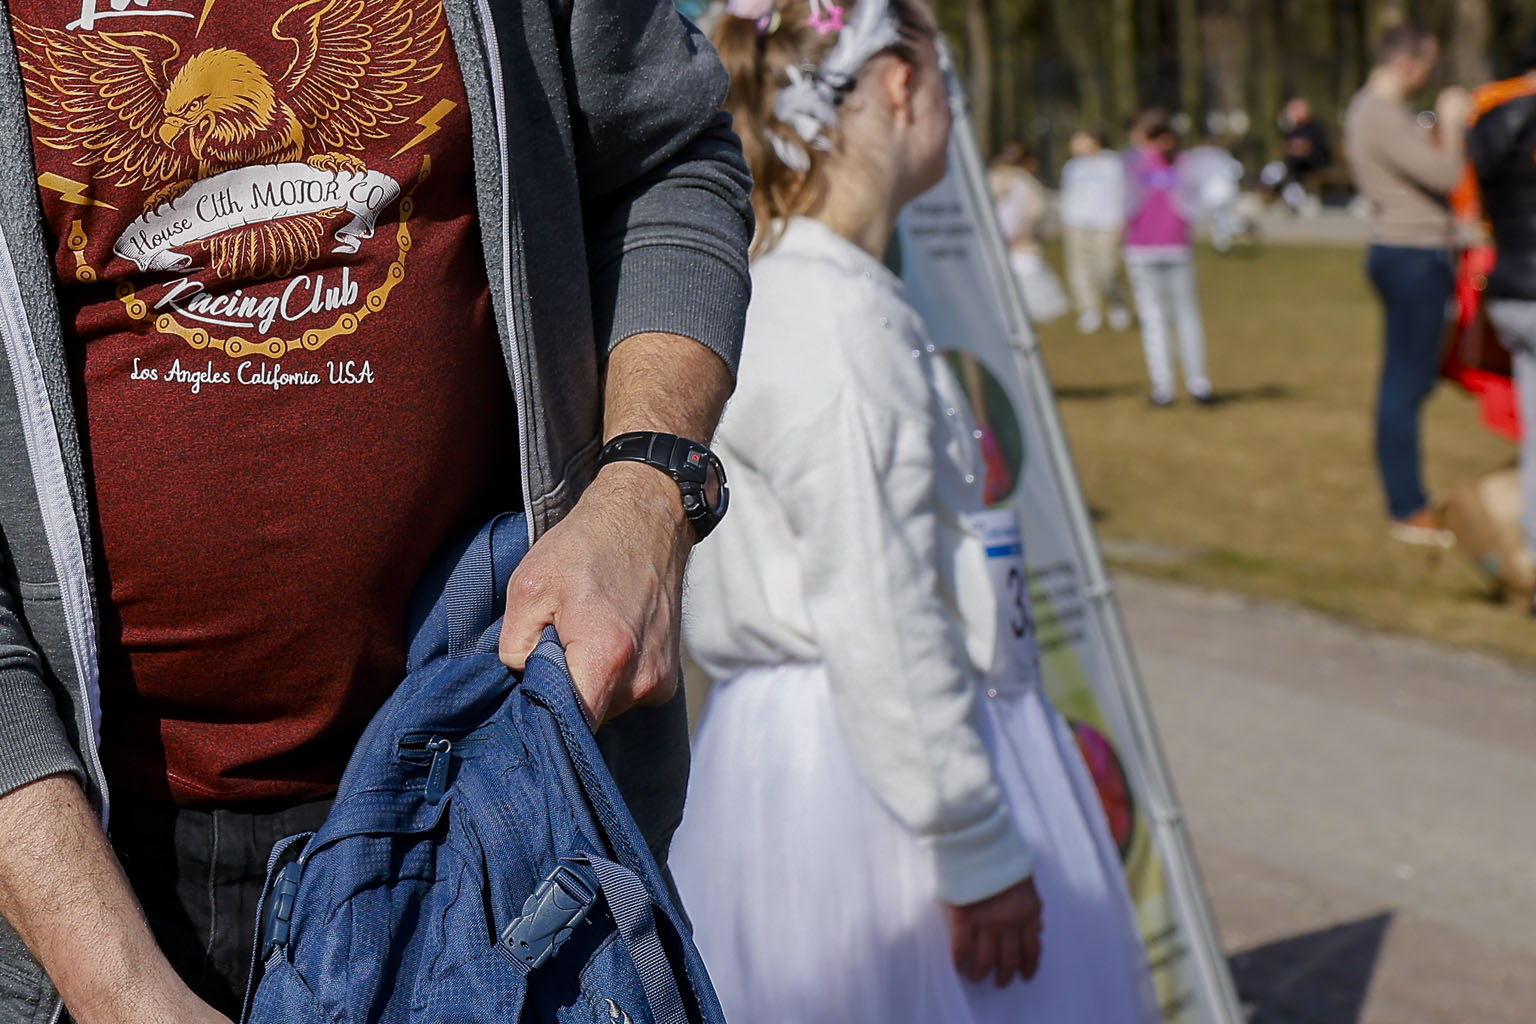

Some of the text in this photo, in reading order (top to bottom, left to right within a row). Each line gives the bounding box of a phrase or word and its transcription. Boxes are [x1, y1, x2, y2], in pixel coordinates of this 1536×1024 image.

[129, 218, 193, 255] House
[250, 179, 341, 210] MOTOR
[349, 180, 385, 211] CO
[153, 266, 359, 335] Racing Club
[129, 357, 375, 394] Los Angeles California USA
